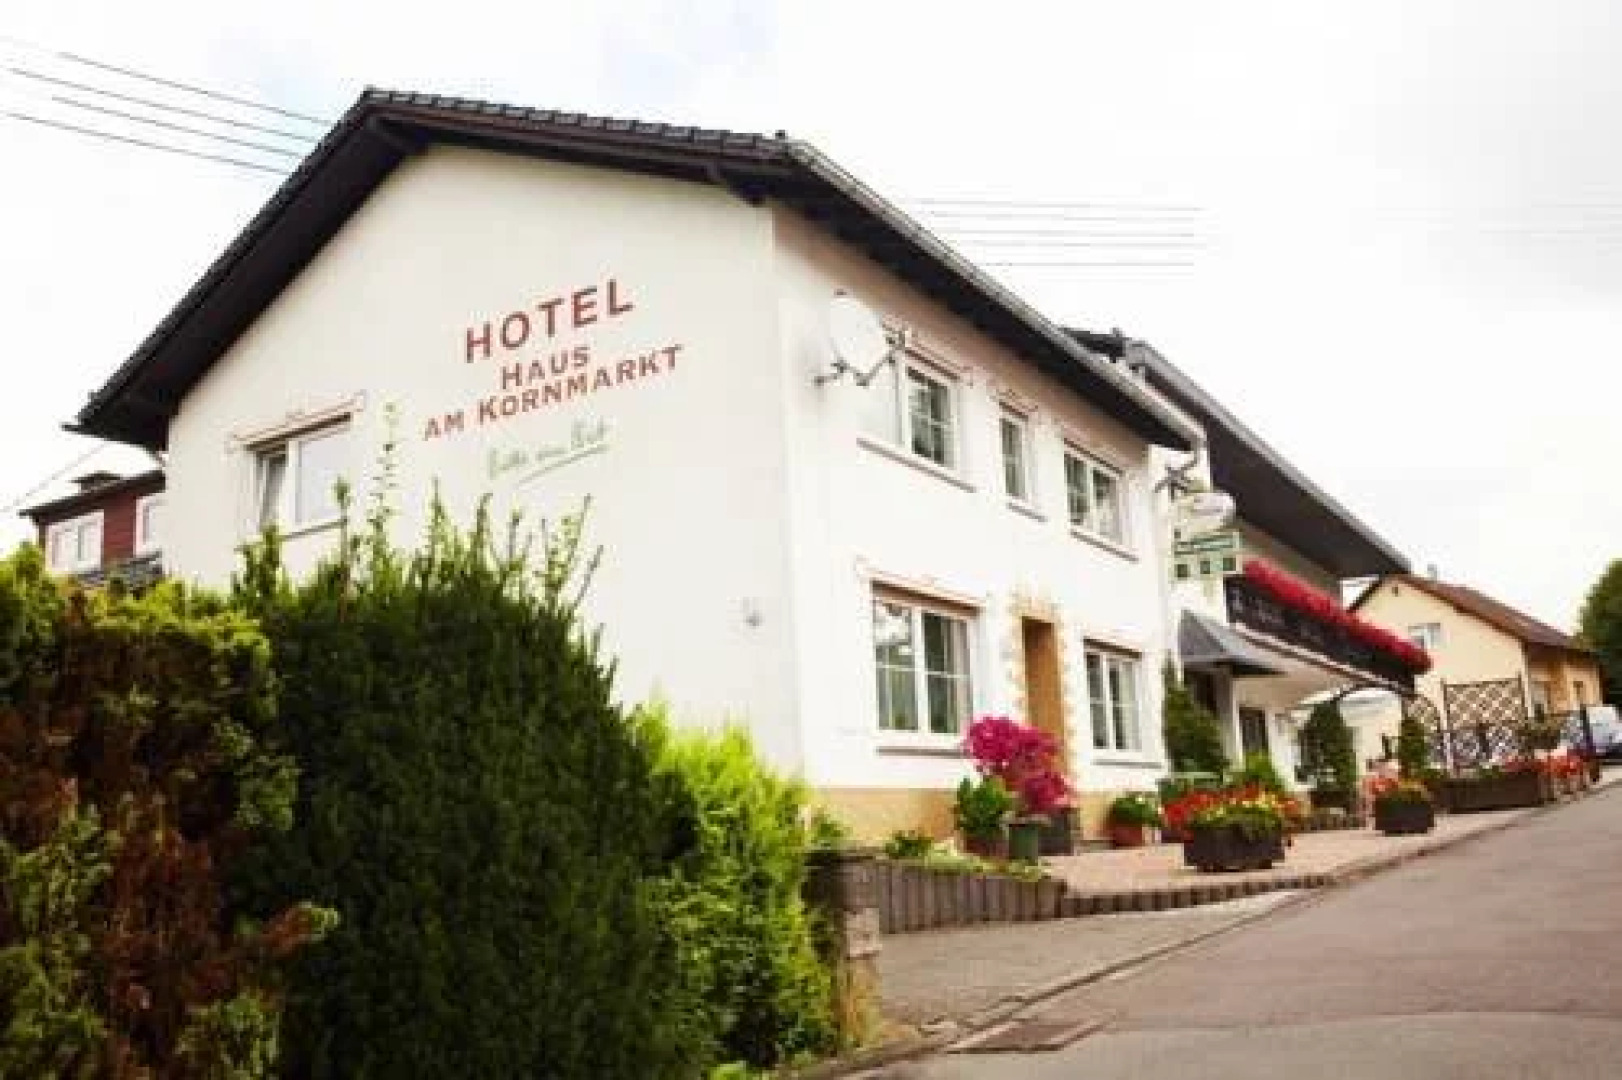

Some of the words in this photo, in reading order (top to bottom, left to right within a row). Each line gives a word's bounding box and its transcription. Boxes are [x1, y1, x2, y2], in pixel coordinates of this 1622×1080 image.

[465, 278, 634, 363] HOTEL
[424, 409, 465, 441] AM
[478, 343, 684, 425] KORNMARKT
[502, 346, 591, 390] HAUS
